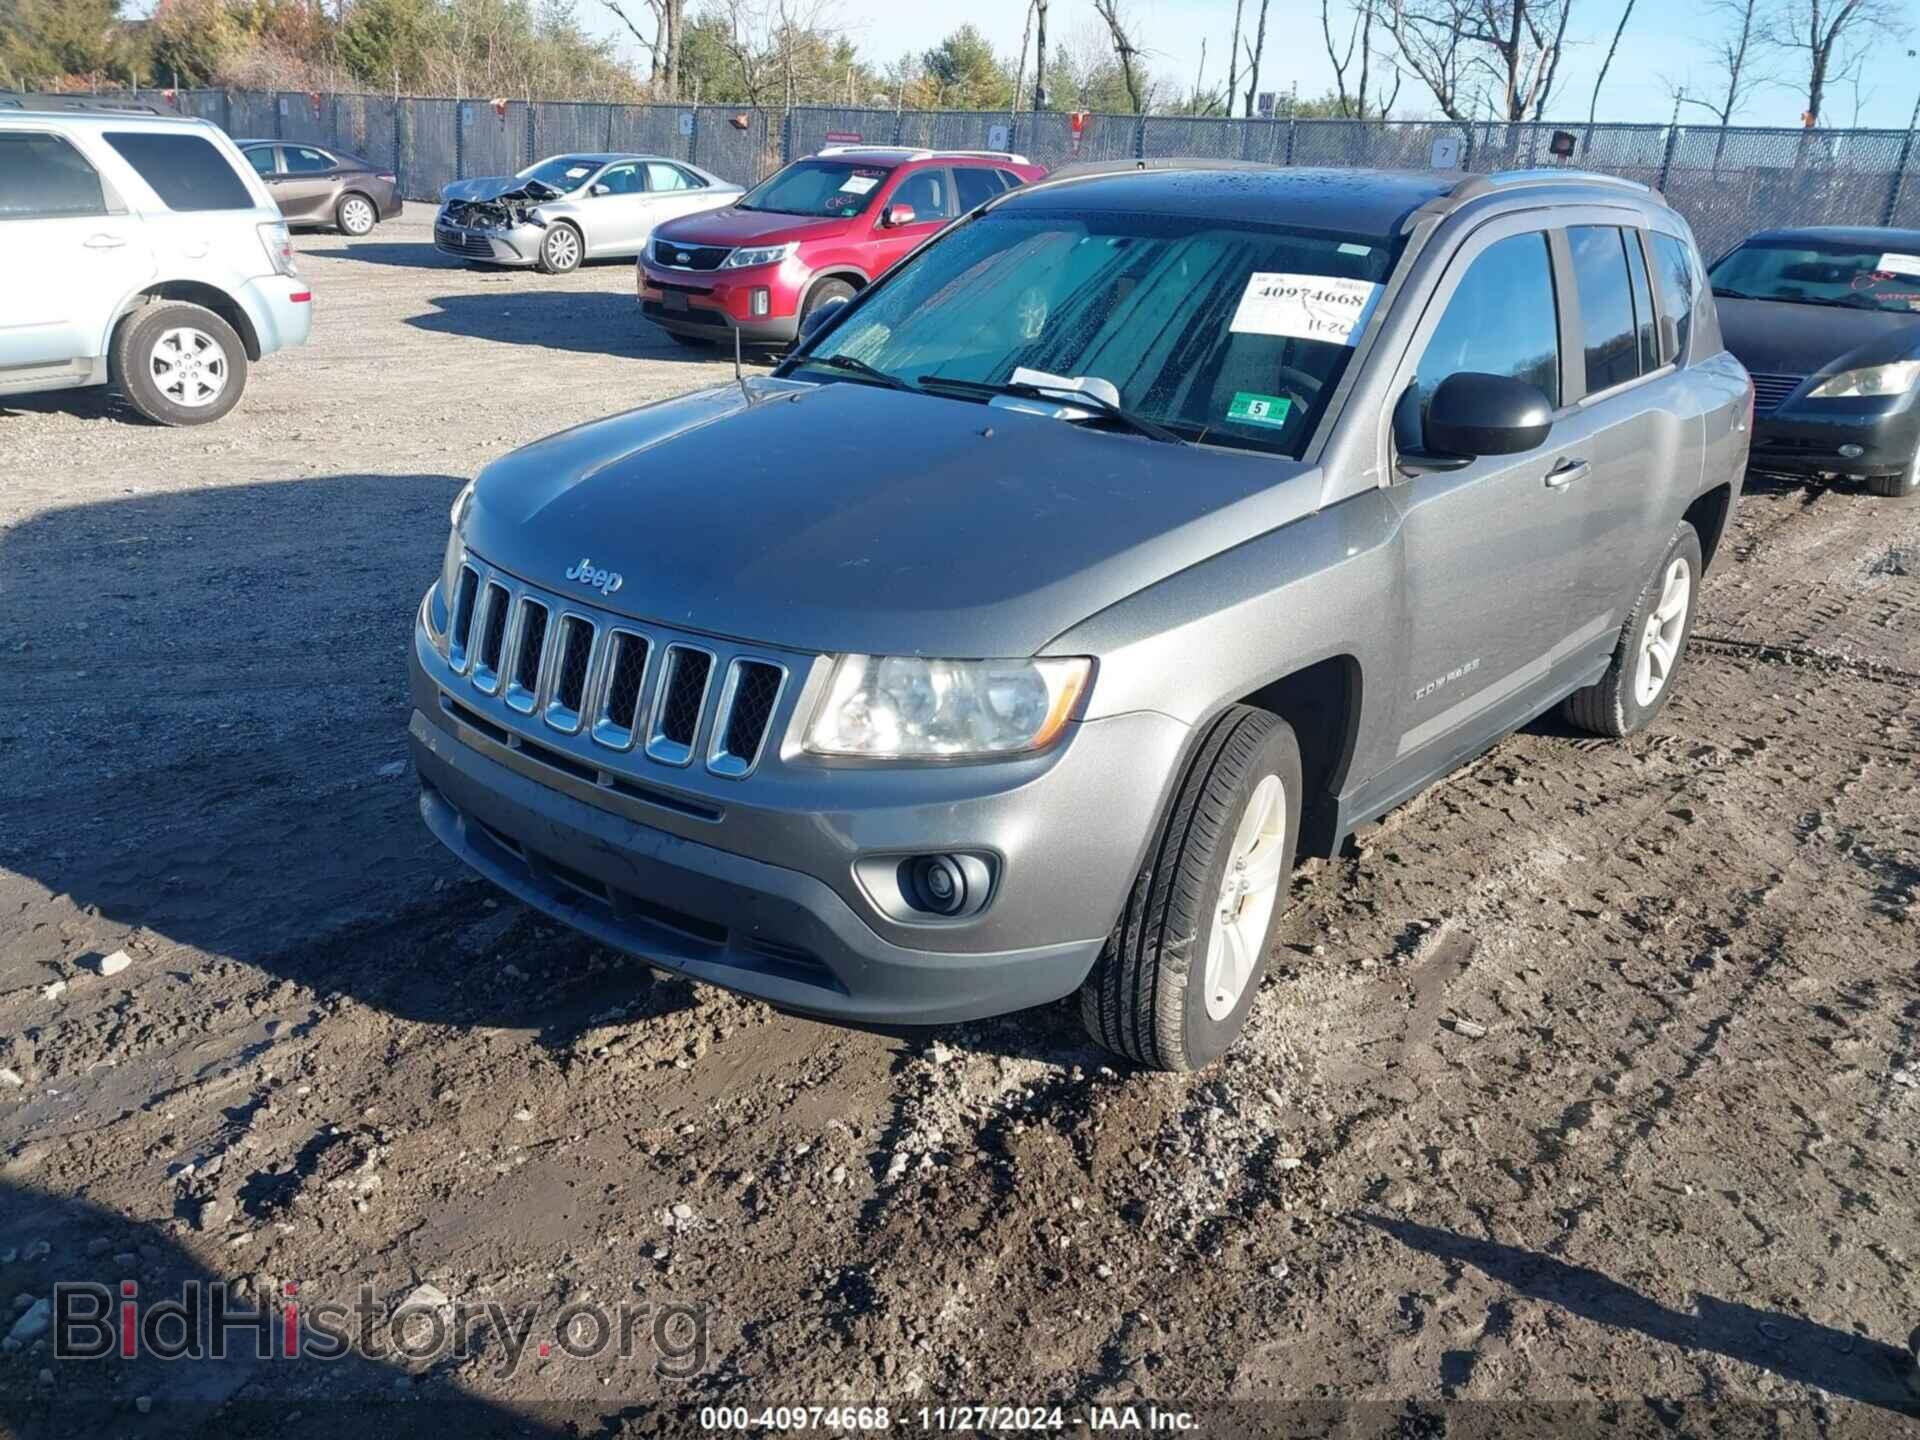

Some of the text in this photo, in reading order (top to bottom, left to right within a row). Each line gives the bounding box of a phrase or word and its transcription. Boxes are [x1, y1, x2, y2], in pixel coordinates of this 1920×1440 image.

[1441, 147, 1449, 158] 7
[1258, 285, 1365, 307] 40974668
[1254, 402, 1263, 414] 5
[565, 558, 623, 597] Jeep
